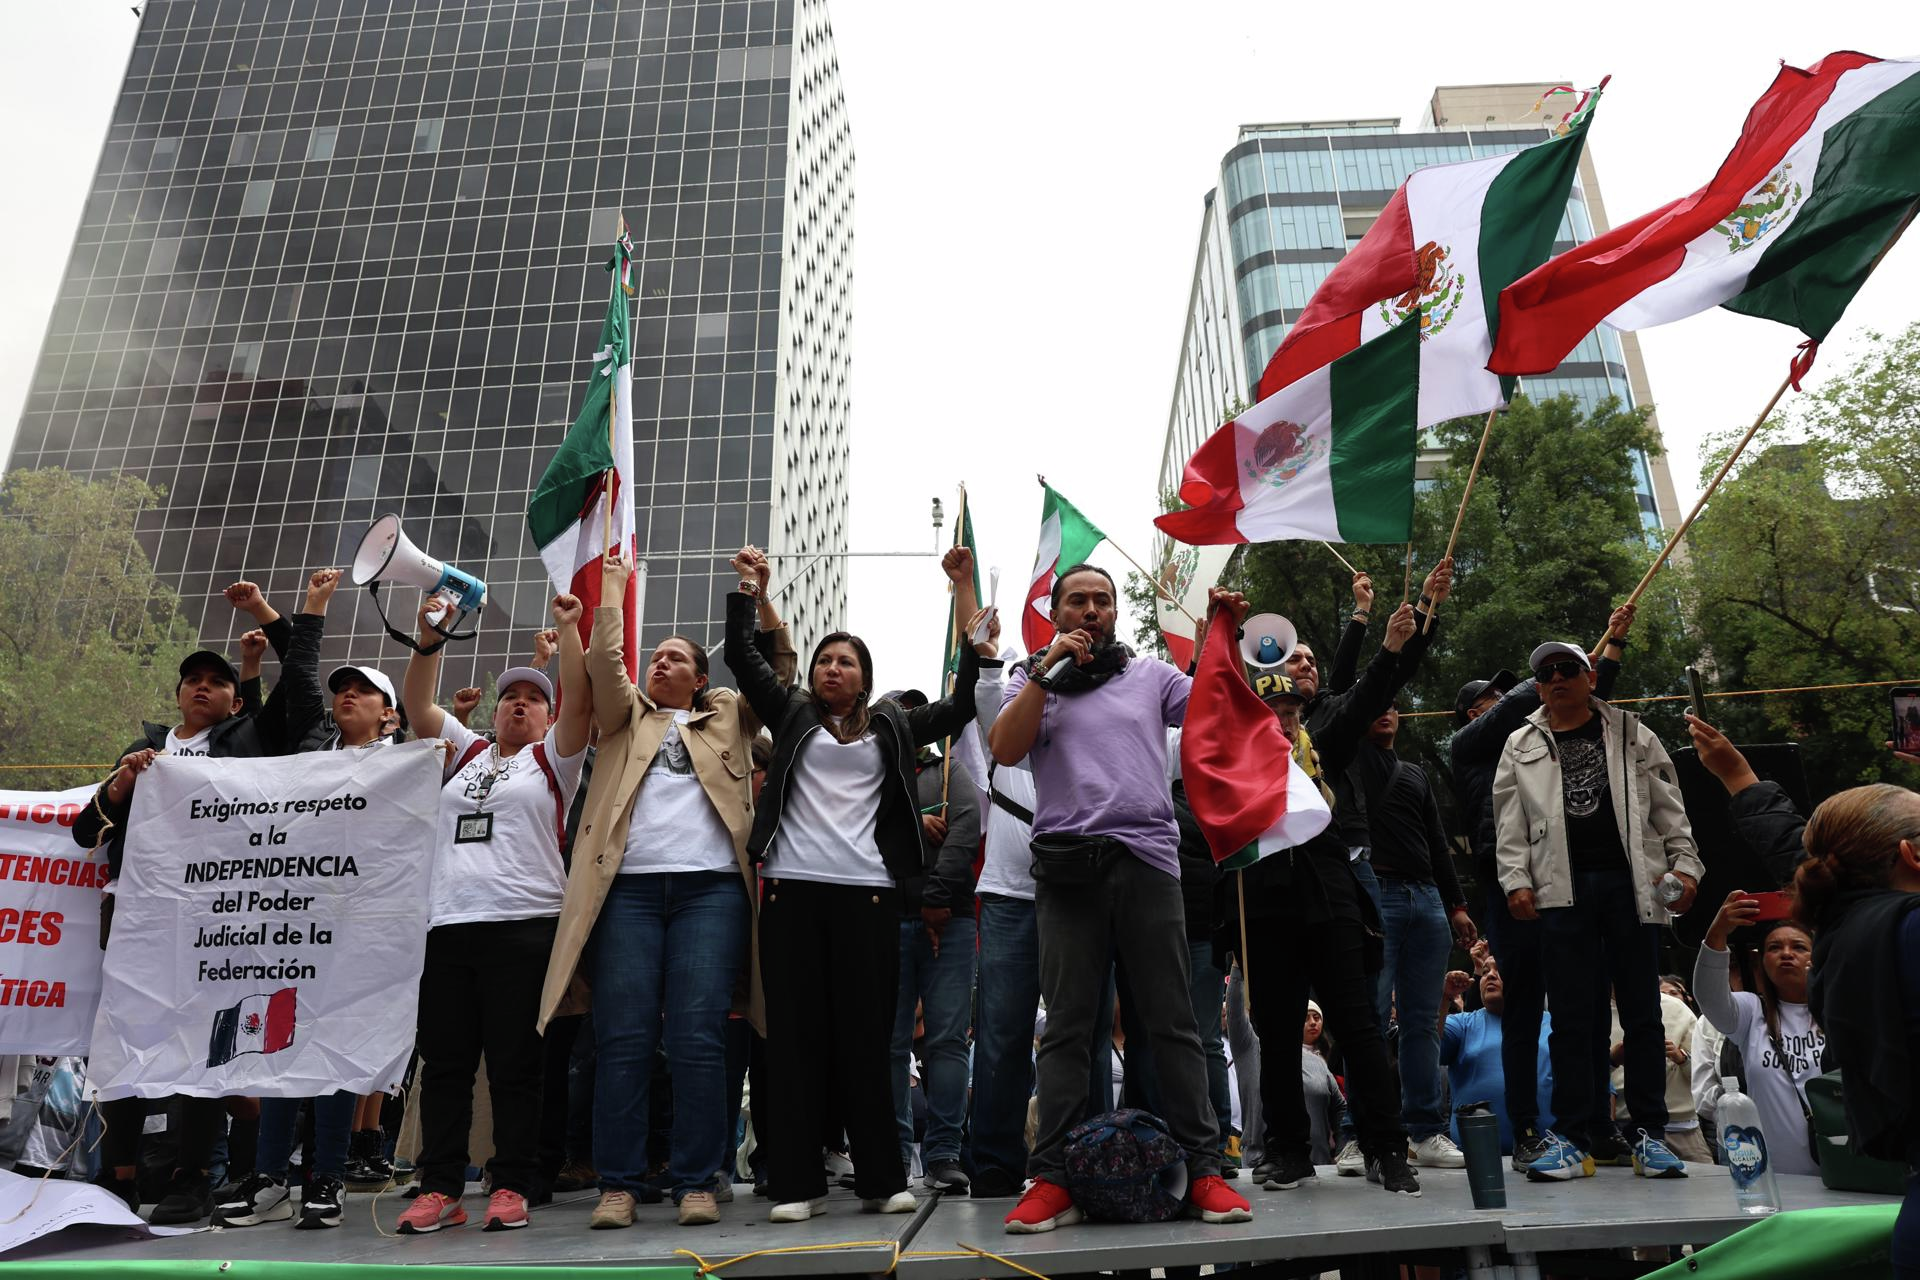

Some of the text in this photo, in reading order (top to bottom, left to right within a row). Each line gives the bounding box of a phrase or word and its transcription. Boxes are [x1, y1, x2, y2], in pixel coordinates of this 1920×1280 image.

[1256, 674, 1293, 697] PJF
[190, 793, 367, 823] Exigimos respeto
[249, 825, 287, 846] a la
[184, 856, 359, 884] INDEPENDENCIA
[212, 889, 315, 913] del Poder
[0, 908, 64, 946] CES
[194, 922, 332, 948] Judicial de la
[198, 958, 316, 982] Federación
[0, 975, 66, 1008] TICA
